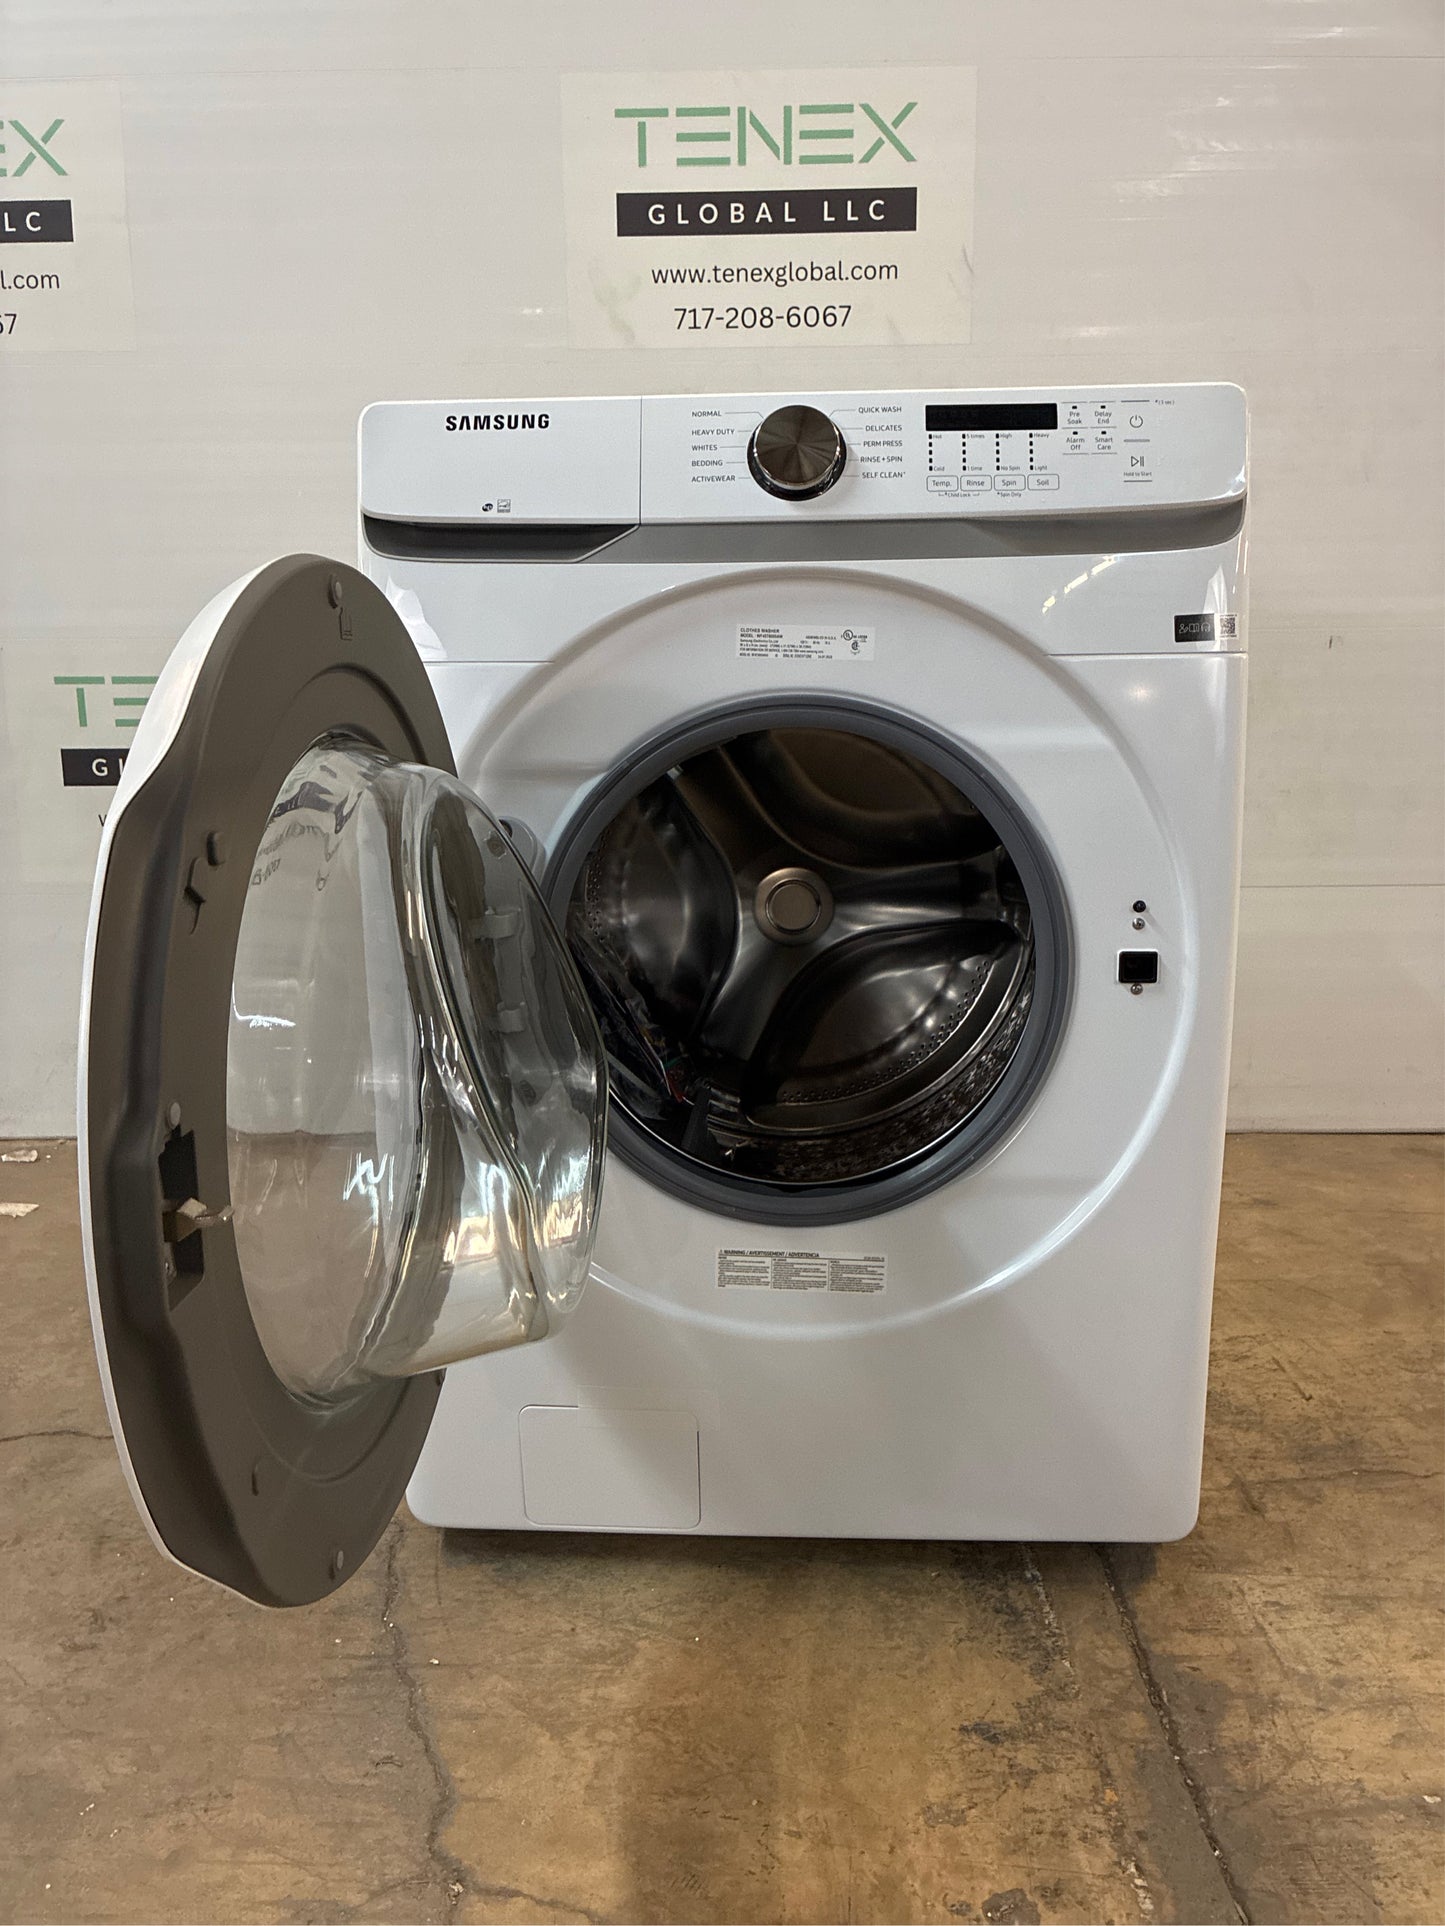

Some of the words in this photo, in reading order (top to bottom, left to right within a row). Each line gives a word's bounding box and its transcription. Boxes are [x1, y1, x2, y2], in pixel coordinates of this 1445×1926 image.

[614, 102, 918, 168] TENEX
[647, 200, 797, 226] GLOBAL
[823, 199, 886, 222] LLC
[651, 260, 899, 288] www.tenexglobal.com
[674, 305, 852, 330] 717-208-6067
[858, 406, 880, 414] QUICK
[445, 413, 550, 432] SAMSUNG
[691, 459, 723, 467] BEDDING
[862, 471, 878, 479] SELF
[932, 480, 952, 488] Temp.
[1002, 479, 1016, 487] Spin
